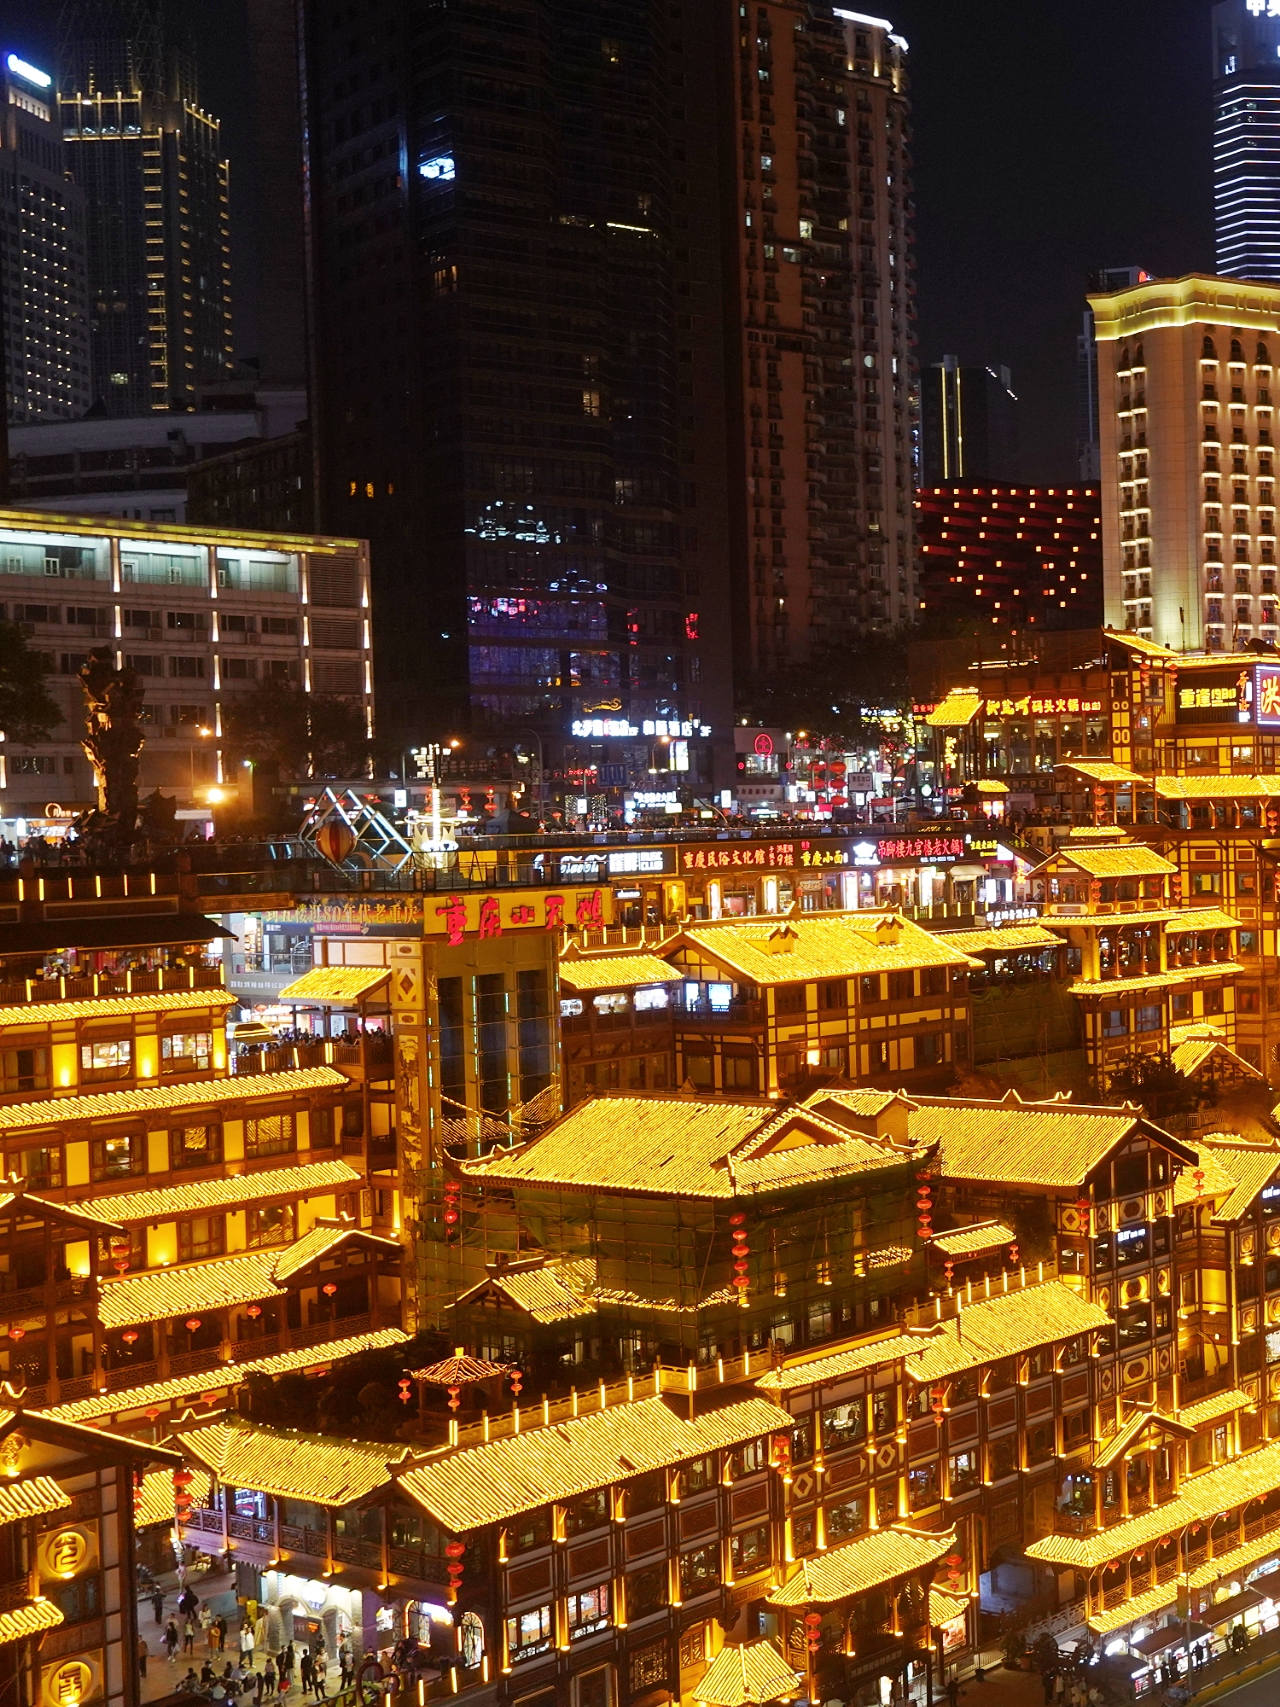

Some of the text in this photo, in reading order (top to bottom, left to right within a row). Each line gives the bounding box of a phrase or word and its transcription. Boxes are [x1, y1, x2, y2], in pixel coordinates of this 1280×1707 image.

[266, 903, 418, 925] 到五楼逛80年代老重庆
[436, 890, 605, 946] 重庆小天鹅
